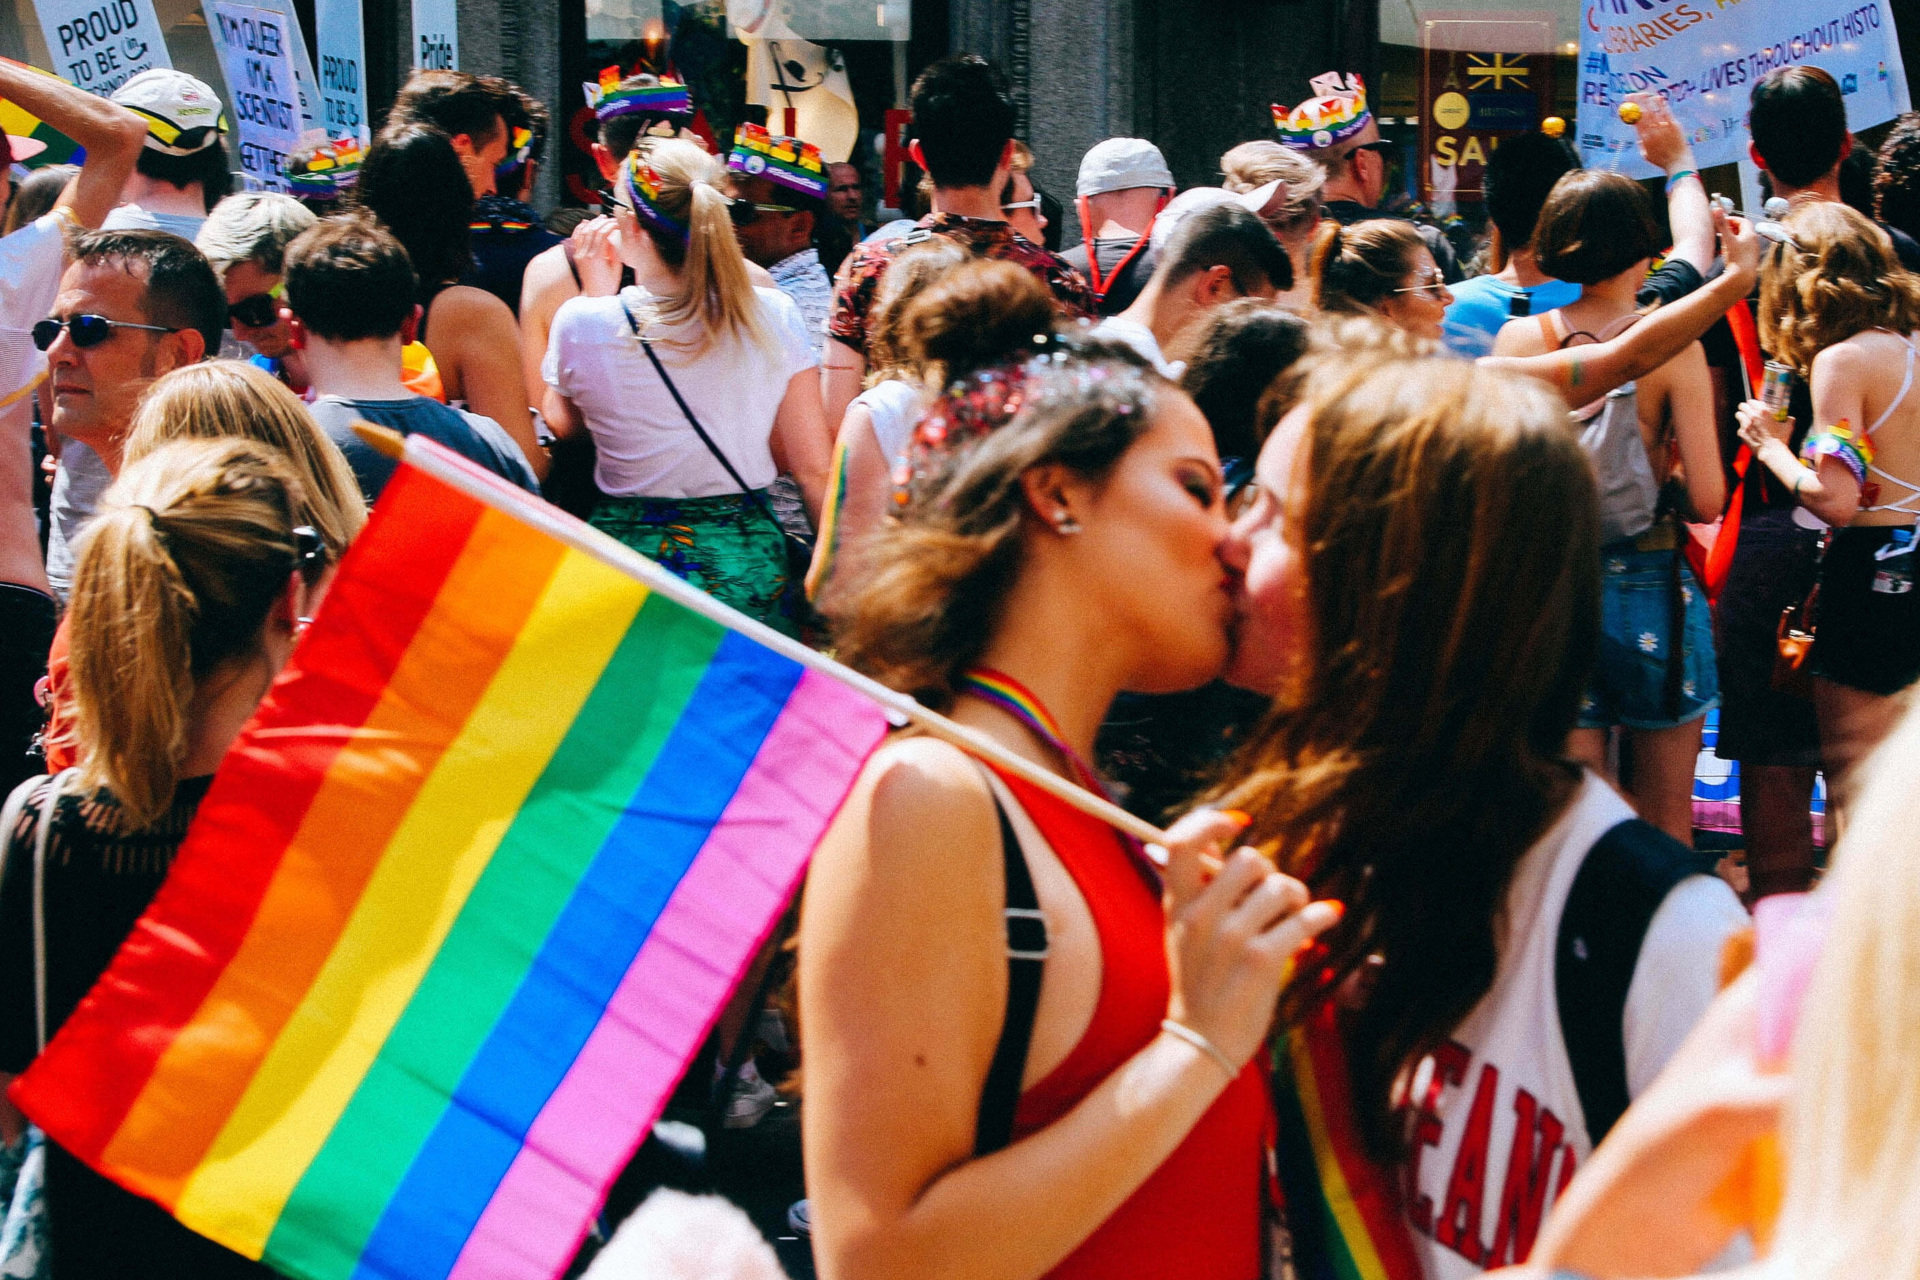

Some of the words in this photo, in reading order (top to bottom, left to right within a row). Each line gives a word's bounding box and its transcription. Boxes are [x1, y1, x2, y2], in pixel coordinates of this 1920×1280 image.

[57, 0, 138, 57] PROUD
[1700, 57, 1747, 94] LIVES
[1748, 18, 1840, 80] THROUGHOUT
[1840, 2, 1880, 41] HISTO
[69, 59, 93, 86] TO
[95, 46, 121, 75] BE
[420, 33, 453, 70] Pride
[322, 54, 358, 95] PROUD
